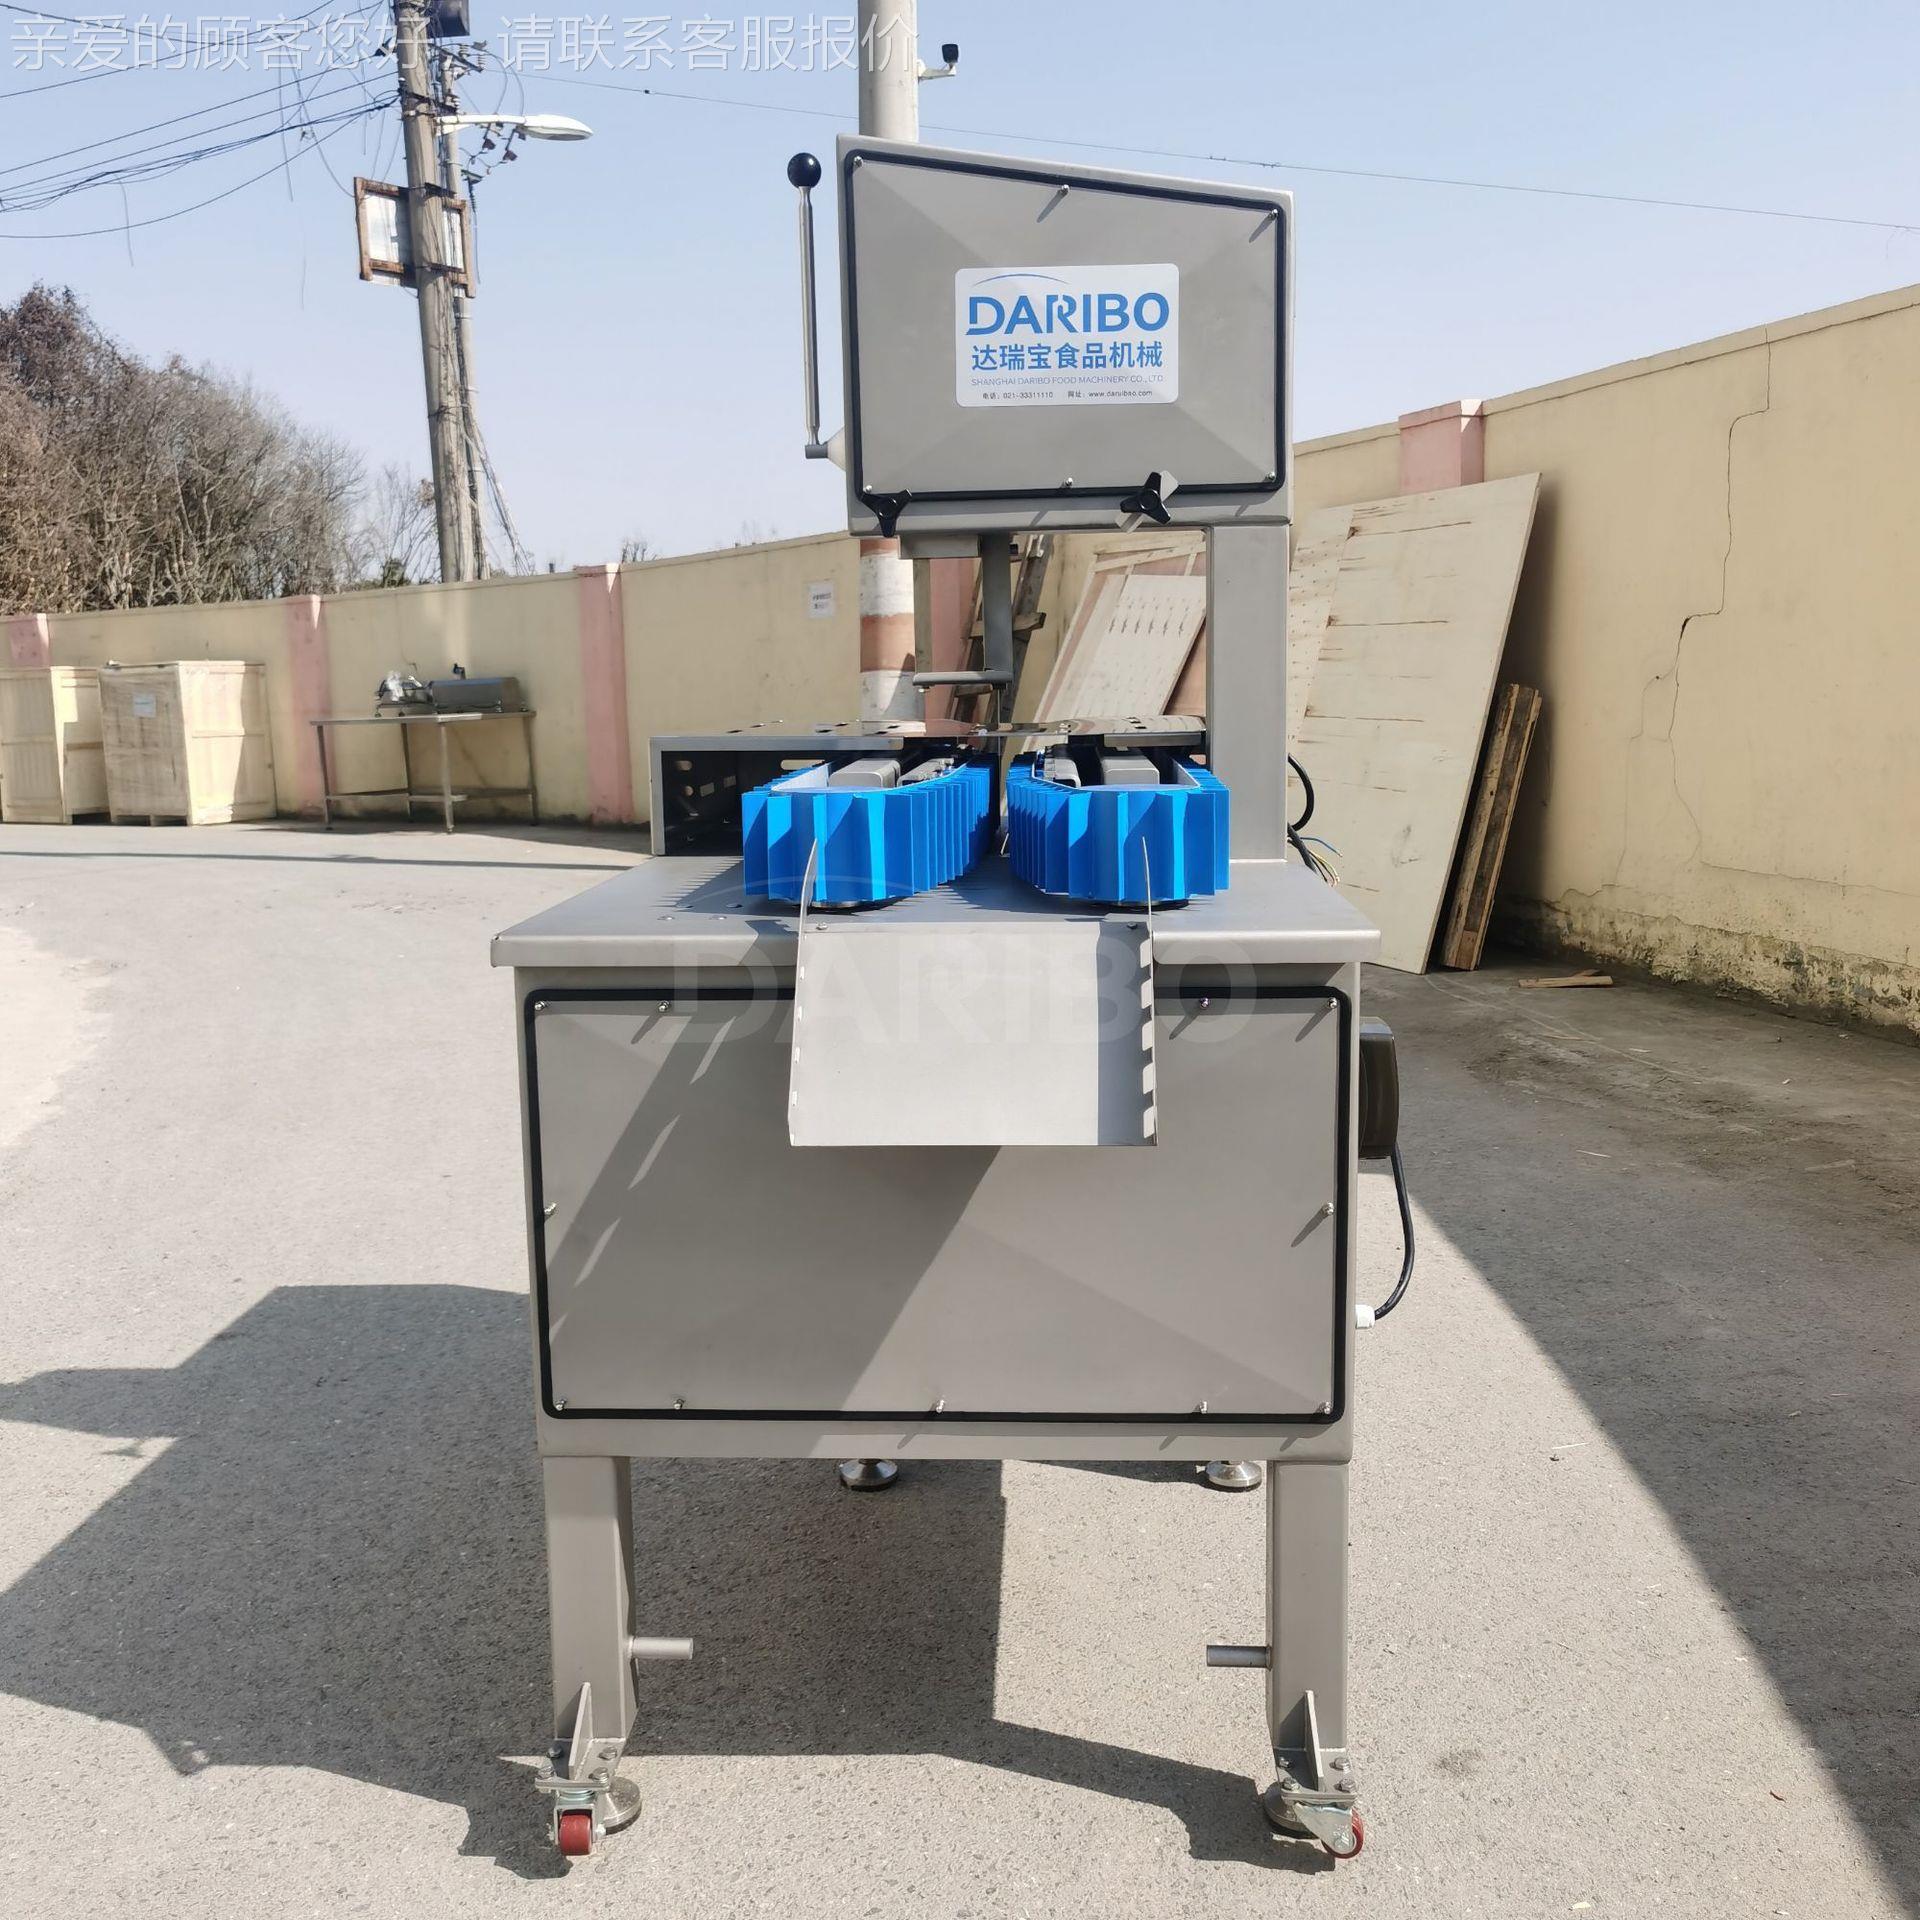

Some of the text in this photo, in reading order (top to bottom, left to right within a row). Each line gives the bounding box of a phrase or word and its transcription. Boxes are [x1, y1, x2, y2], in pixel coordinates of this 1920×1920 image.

[966, 292, 1170, 335] DARIBO
[971, 340, 1163, 371] 达瑞宝食品机械
[971, 377, 1015, 386] SHANGHAI
[1017, 376, 1051, 385] DARIBO
[1052, 376, 1077, 385] FOOD
[1078, 375, 1129, 384] MACHINERY
